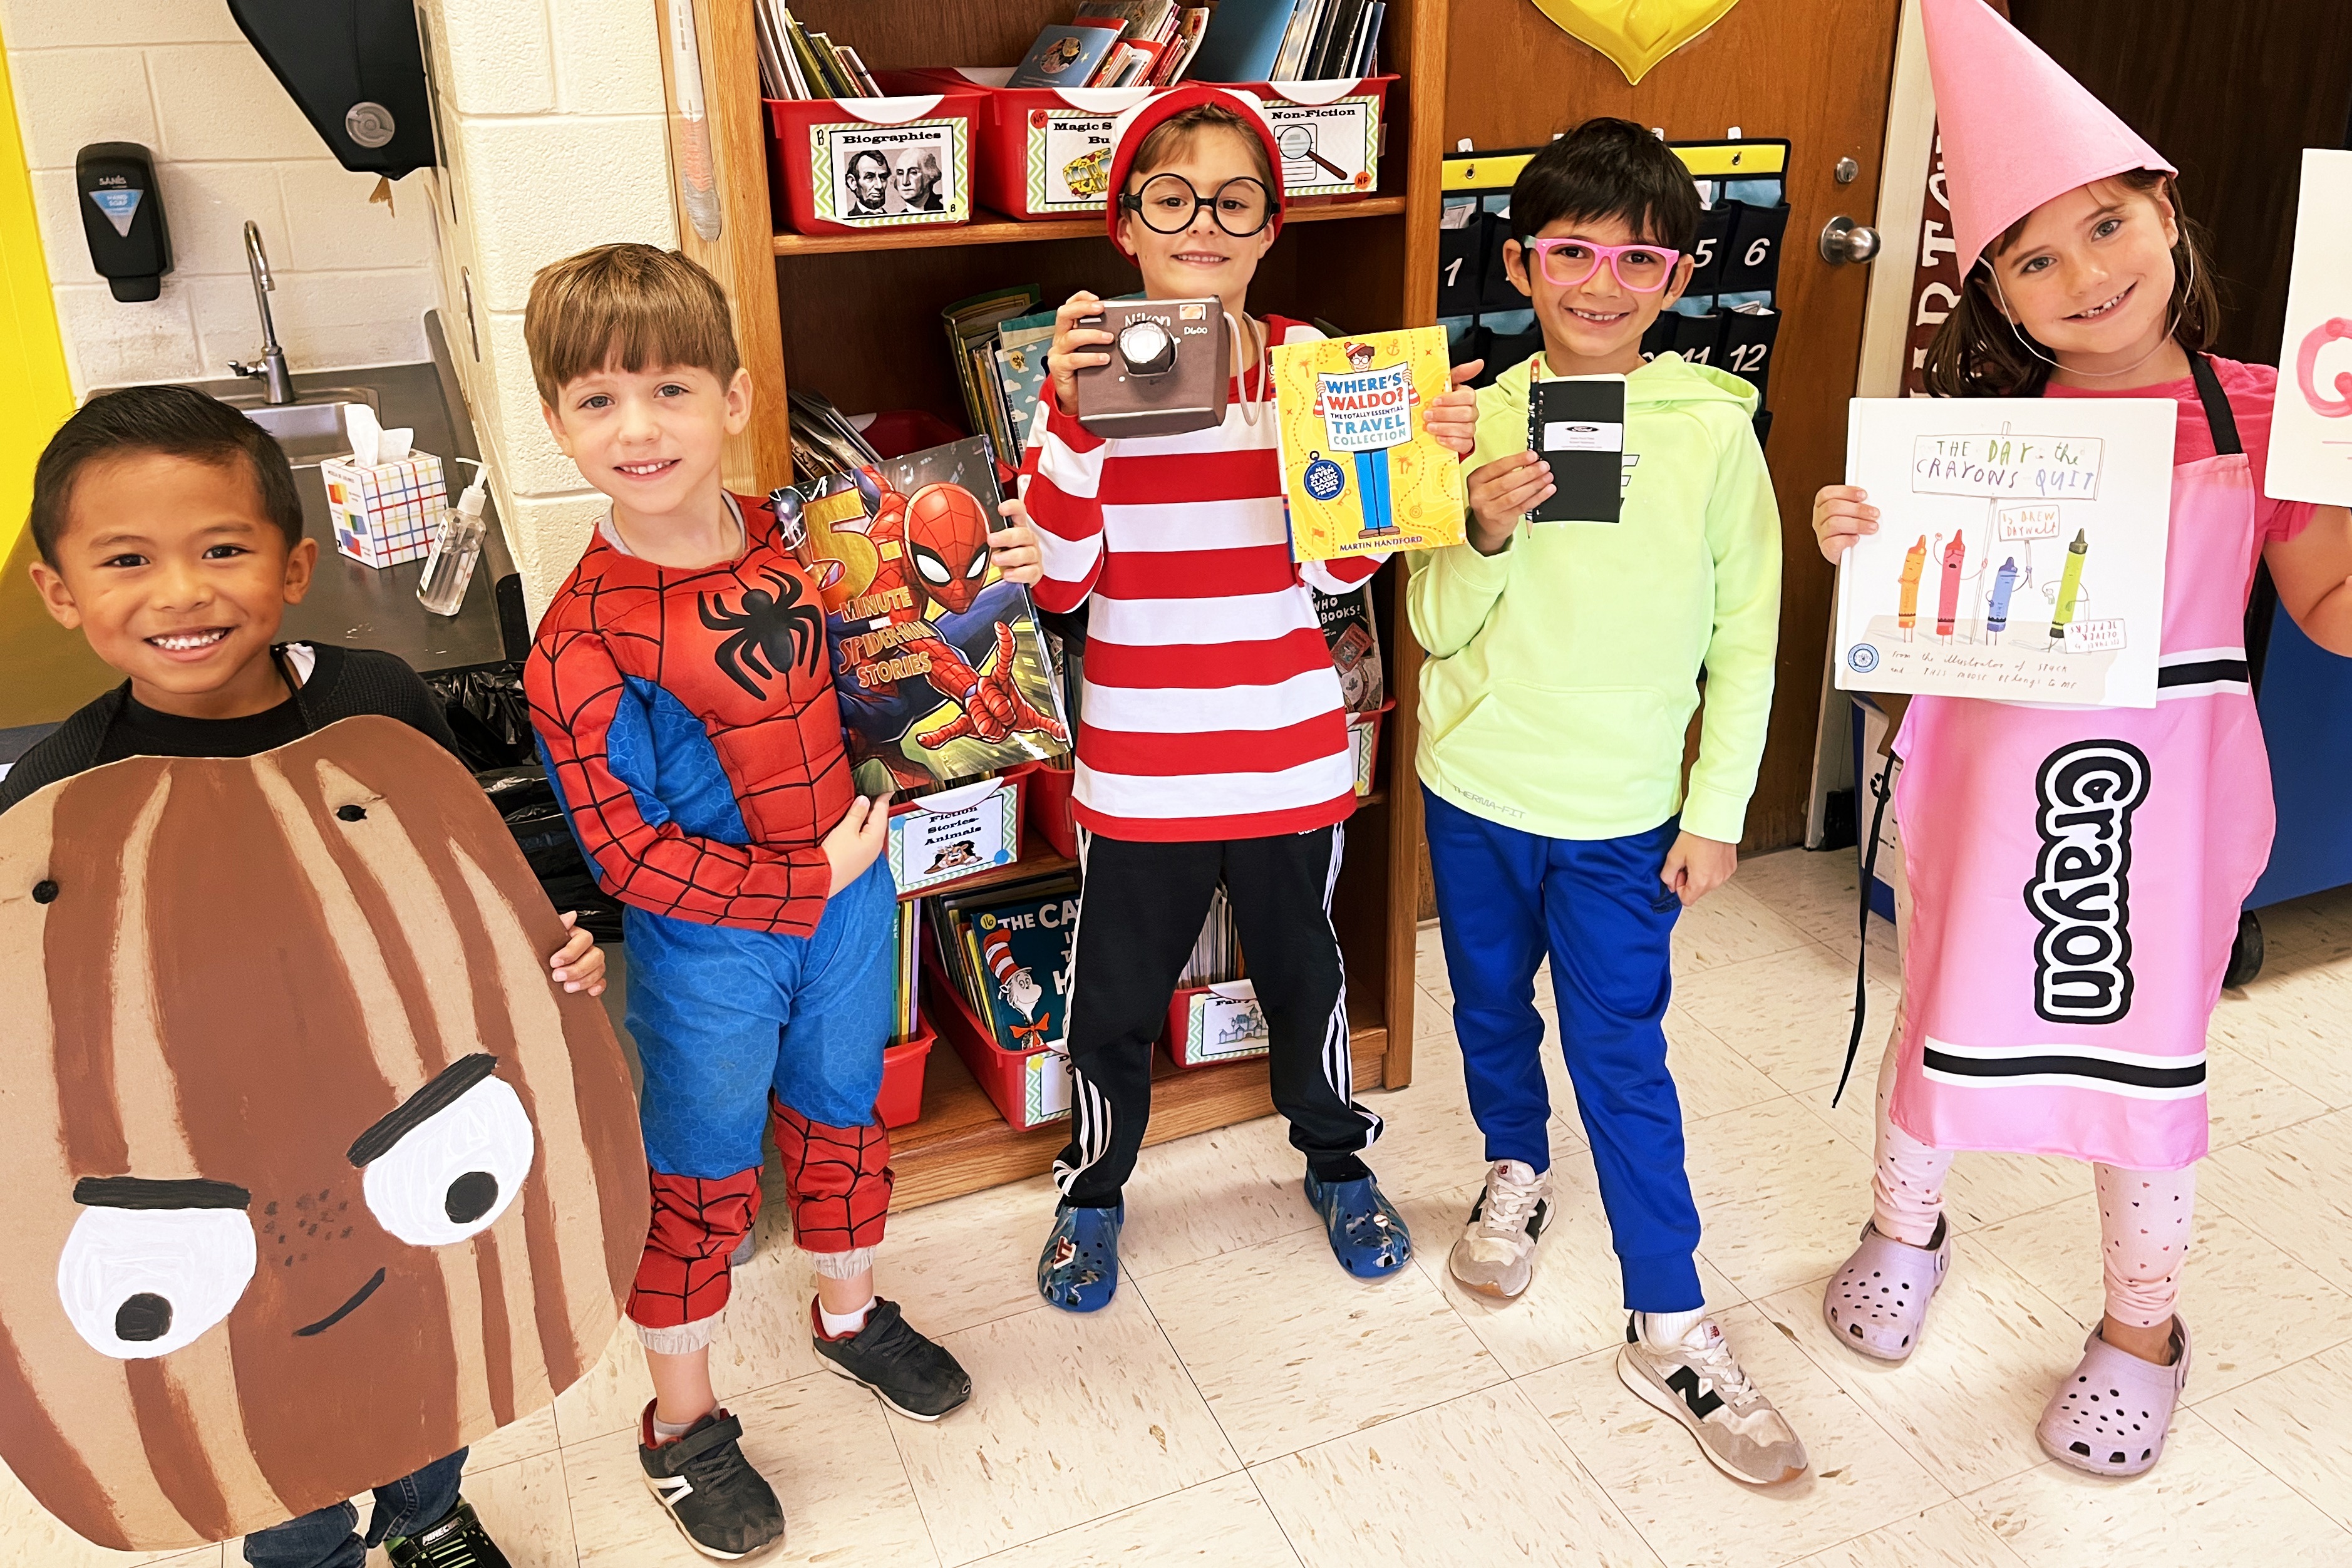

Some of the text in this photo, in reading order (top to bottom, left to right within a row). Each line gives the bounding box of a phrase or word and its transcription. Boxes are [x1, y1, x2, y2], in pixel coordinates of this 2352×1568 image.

[1272, 110, 1355, 120] Non-Fiction
[1054, 122, 1099, 132] Magic
[817, 130, 824, 145] B
[843, 132, 941, 144] Biographies
[1694, 238, 1717, 267] 5
[1745, 238, 1770, 266] 6
[1445, 258, 1463, 286] 1
[1125, 312, 1171, 327] Nikon
[1730, 344, 1767, 372] 12
[1326, 372, 1401, 394] WHERE'S
[1327, 387, 1403, 411] WALDO?
[1344, 411, 1370, 420] TOTALLY
[1371, 405, 1403, 416] ESSENTIAL
[1332, 415, 1405, 435] TRAVEL
[1334, 428, 1406, 445] COLLECTION
[1937, 440, 2078, 466] THE DAY the
[1917, 458, 2094, 496] CRAYONS QUIT
[2021, 510, 2055, 522] DREW
[1340, 536, 1423, 552] MARTIN HANDFORD
[840, 586, 913, 622] MINUTE
[1321, 604, 1360, 624] BOOKS!
[839, 621, 936, 674] SPIDER-MAN
[857, 651, 932, 688] STORIES
[1944, 654, 2003, 668] illustrator
[924, 826, 981, 845] Animals
[927, 818, 979, 834] Stories-
[2028, 746, 2143, 1018] Crayon
[998, 913, 1035, 931] THE
[1053, 1235, 1077, 1270] VT
